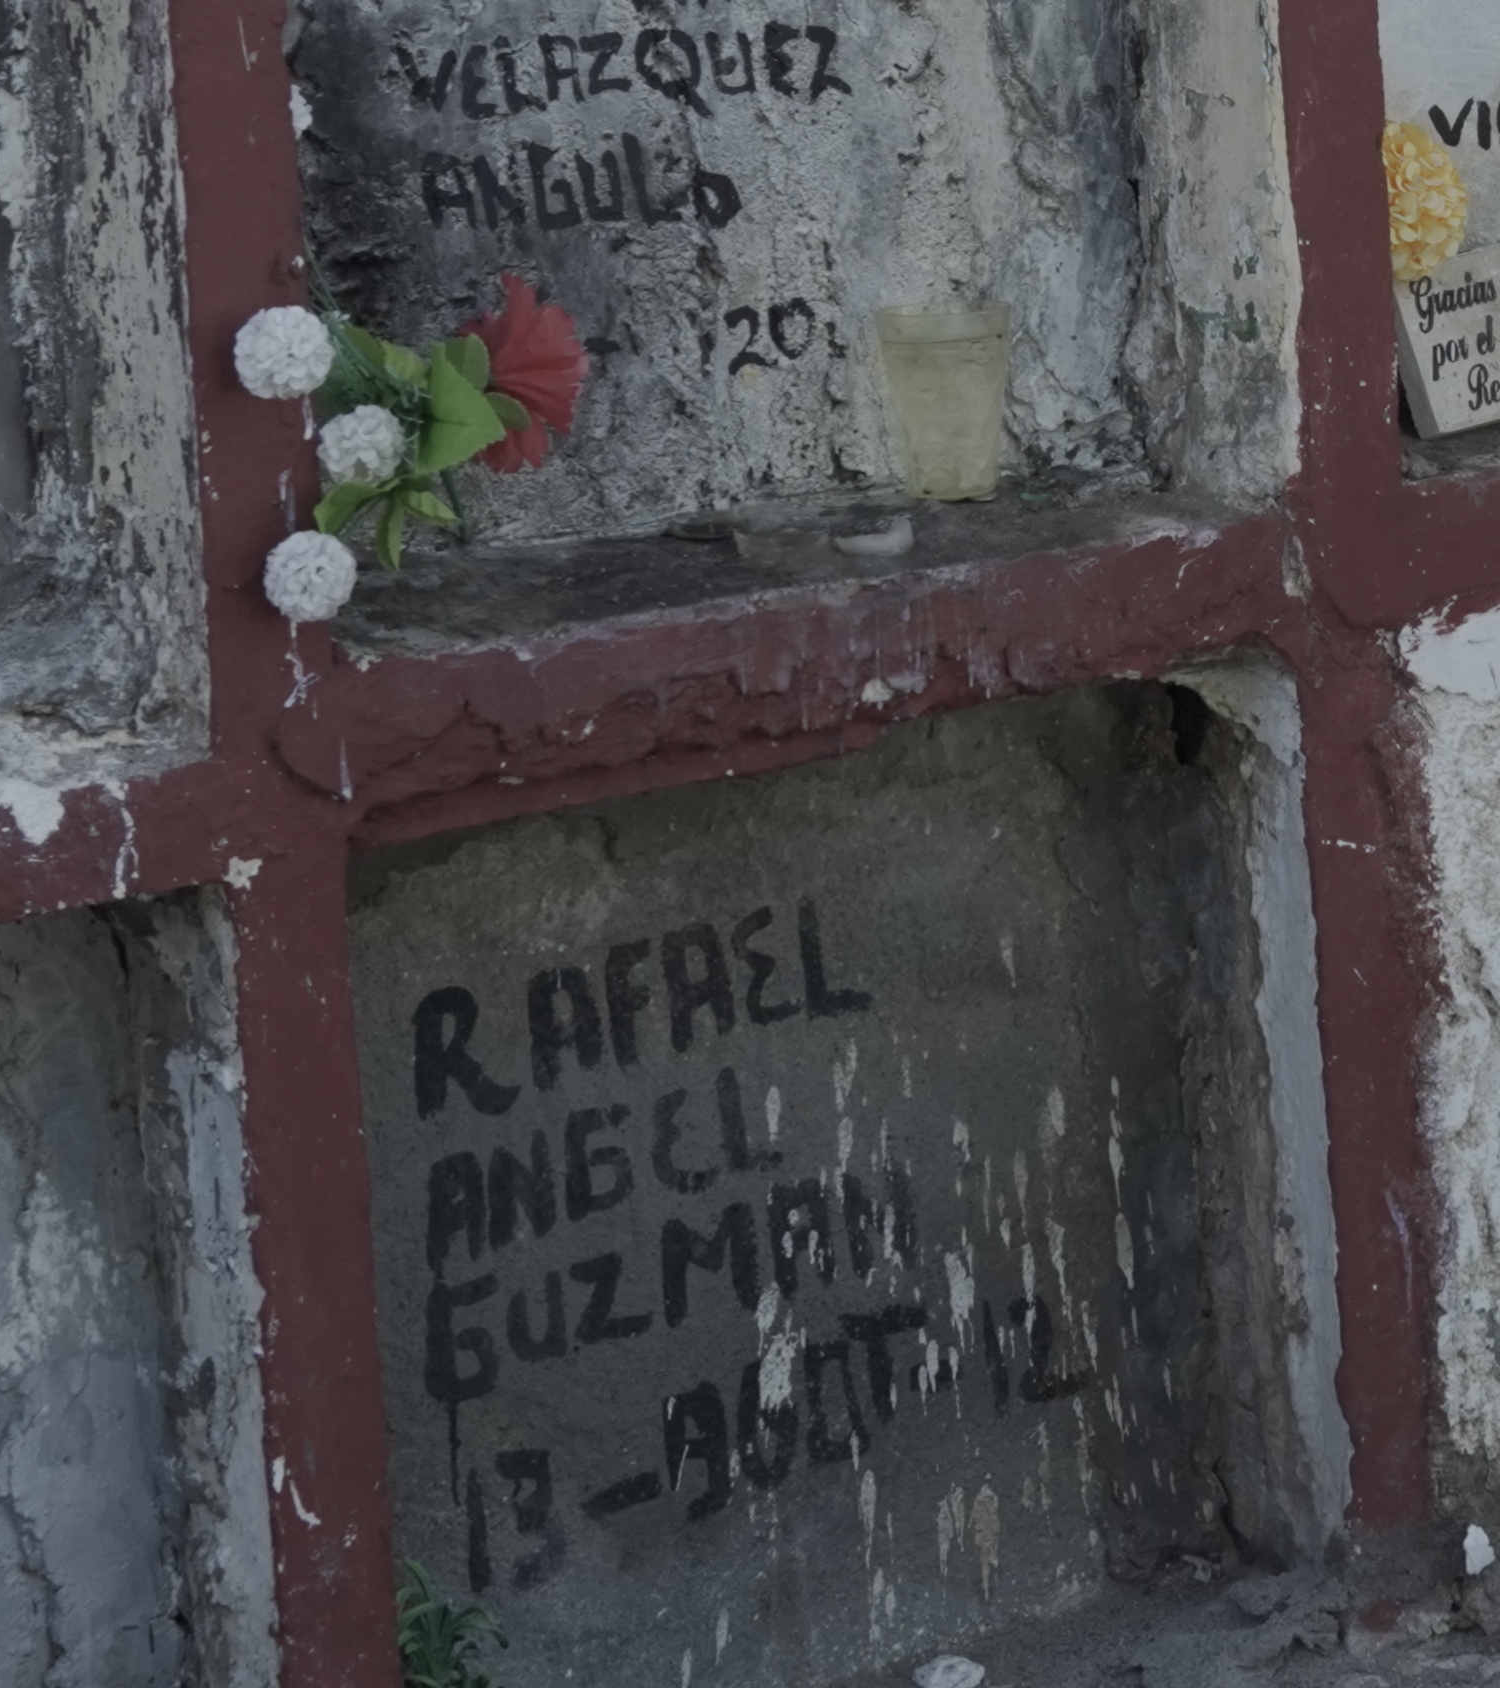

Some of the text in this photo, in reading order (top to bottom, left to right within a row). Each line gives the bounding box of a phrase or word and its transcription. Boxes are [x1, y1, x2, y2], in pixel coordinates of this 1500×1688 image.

[398, 21, 854, 119] VELAZQUEZ
[420, 134, 743, 231] ANGULO
[1410, 267, 1498, 334] Gracias
[1430, 334, 1472, 381] por
[1476, 310, 1496, 356] el
[411, 894, 873, 1119] RAFAEL
[426, 1064, 783, 1272] ANGEL
